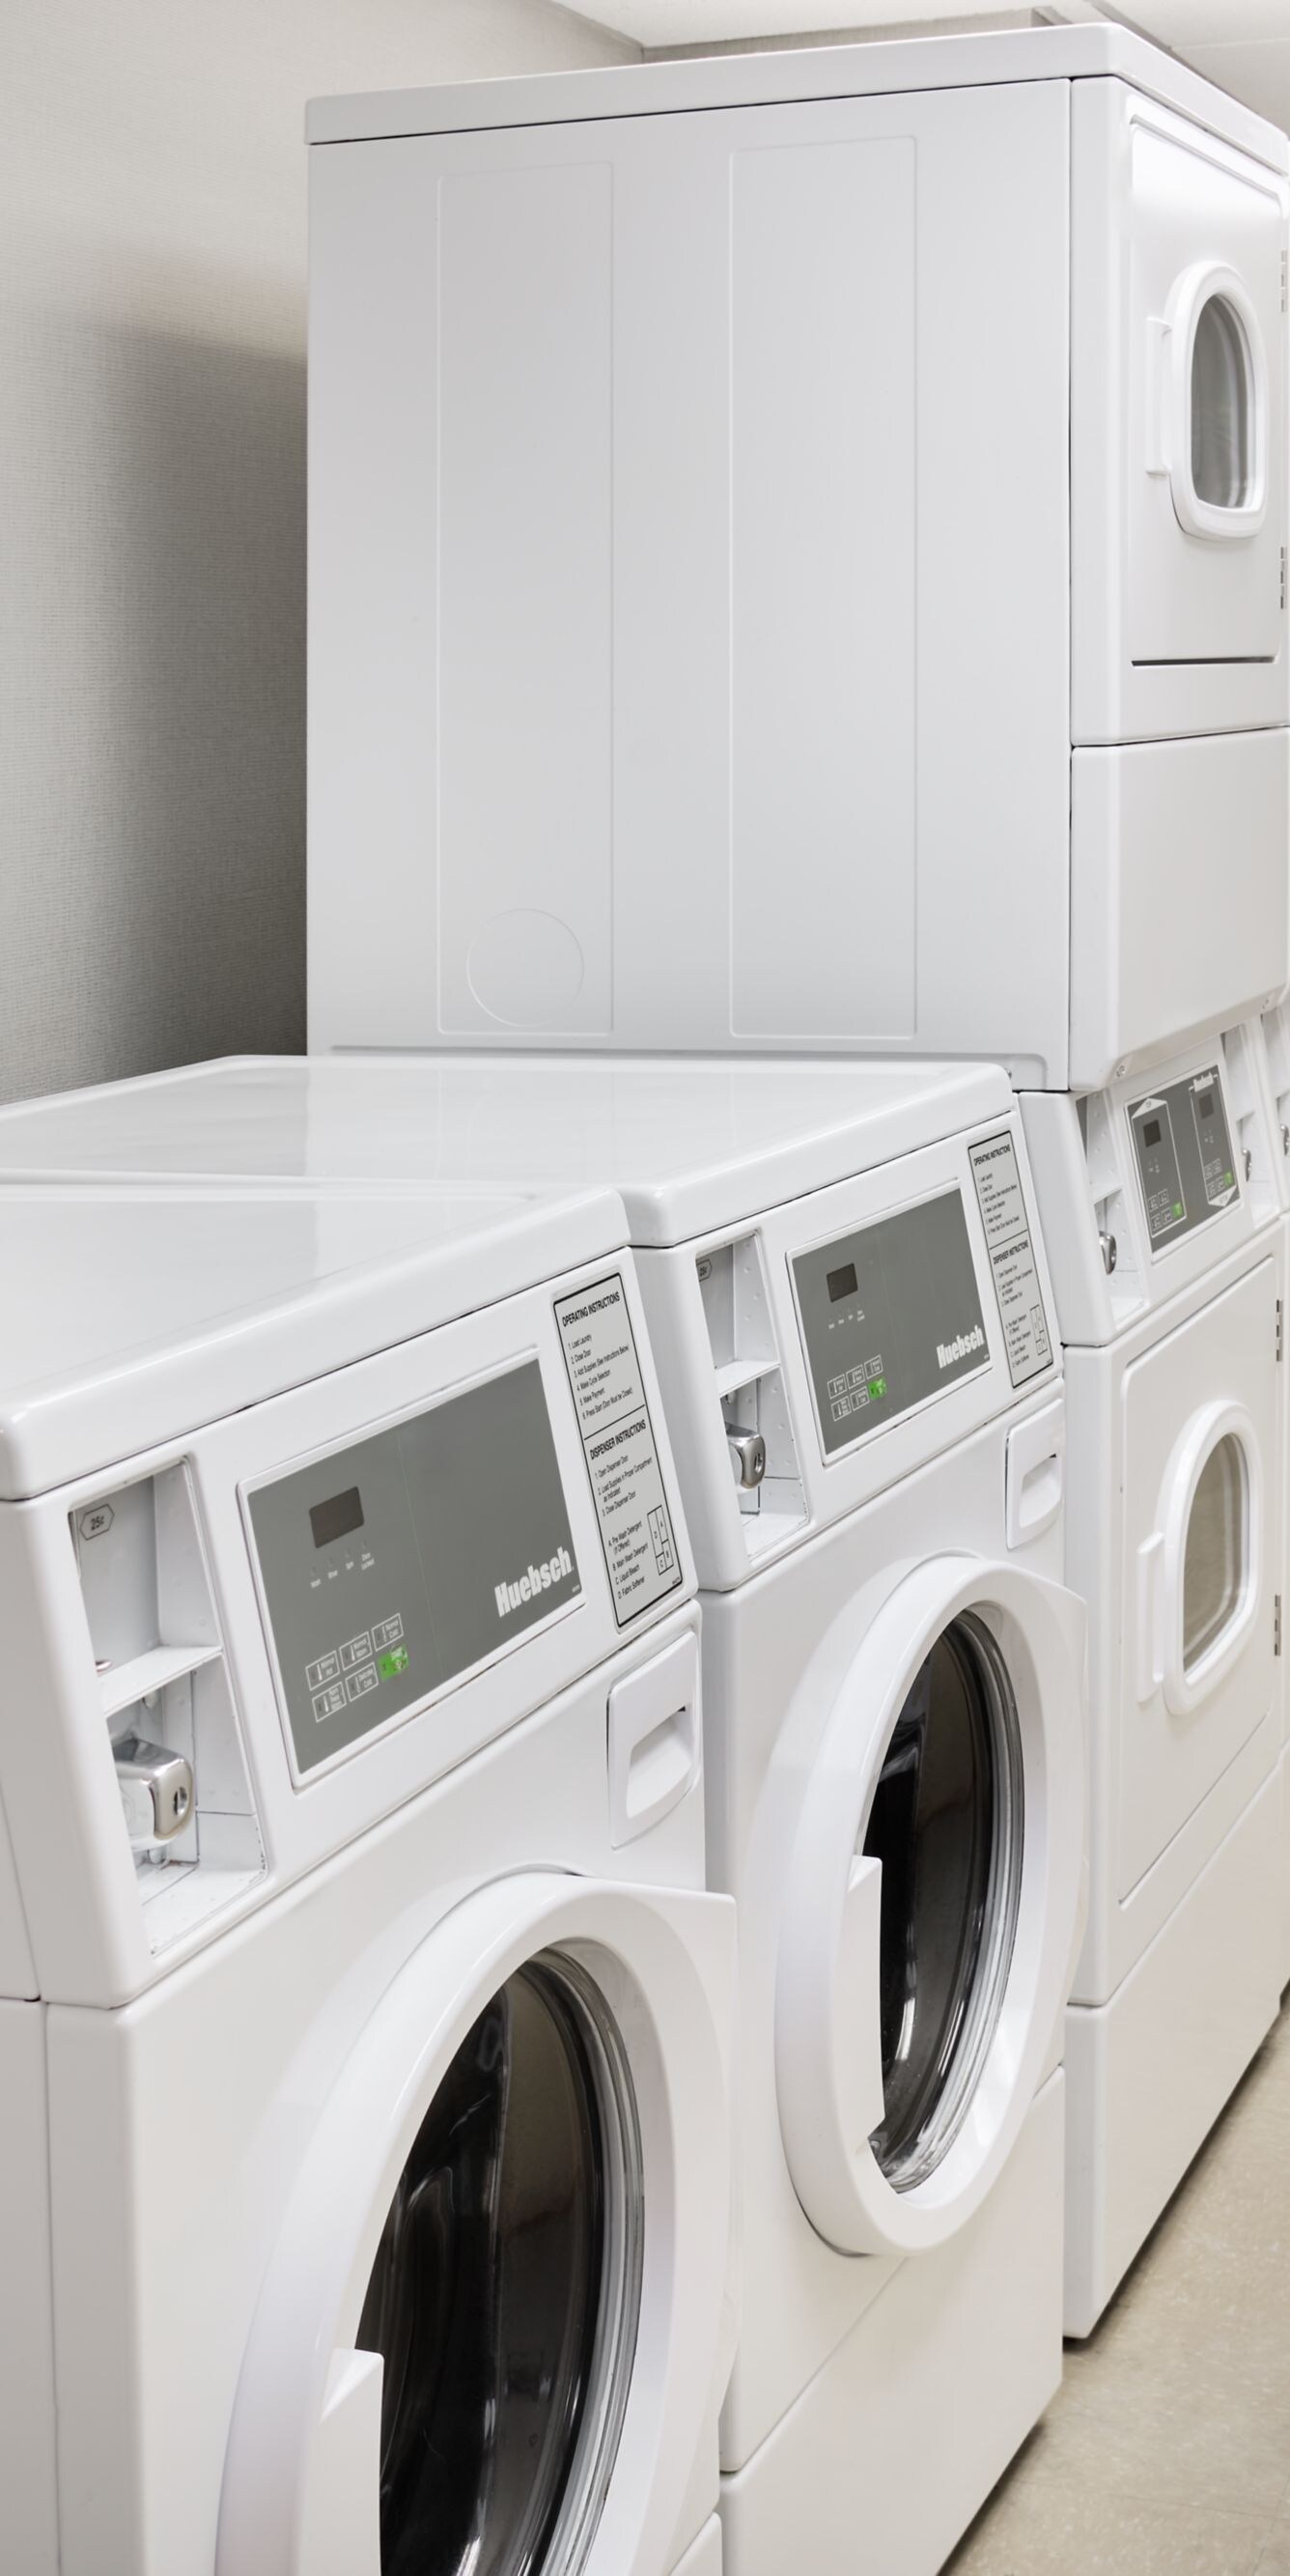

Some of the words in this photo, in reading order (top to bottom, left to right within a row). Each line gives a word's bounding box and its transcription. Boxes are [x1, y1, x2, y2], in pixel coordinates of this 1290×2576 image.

[562, 1307, 588, 1327] OPERATING
[588, 1291, 620, 1314] INSTRUCTIONS
[937, 1325, 984, 1368] Huebsch
[590, 1437, 615, 1459] DISPENSER
[615, 1419, 646, 1444] INSTRUCTIONS
[494, 1546, 572, 1617] Huebsch
